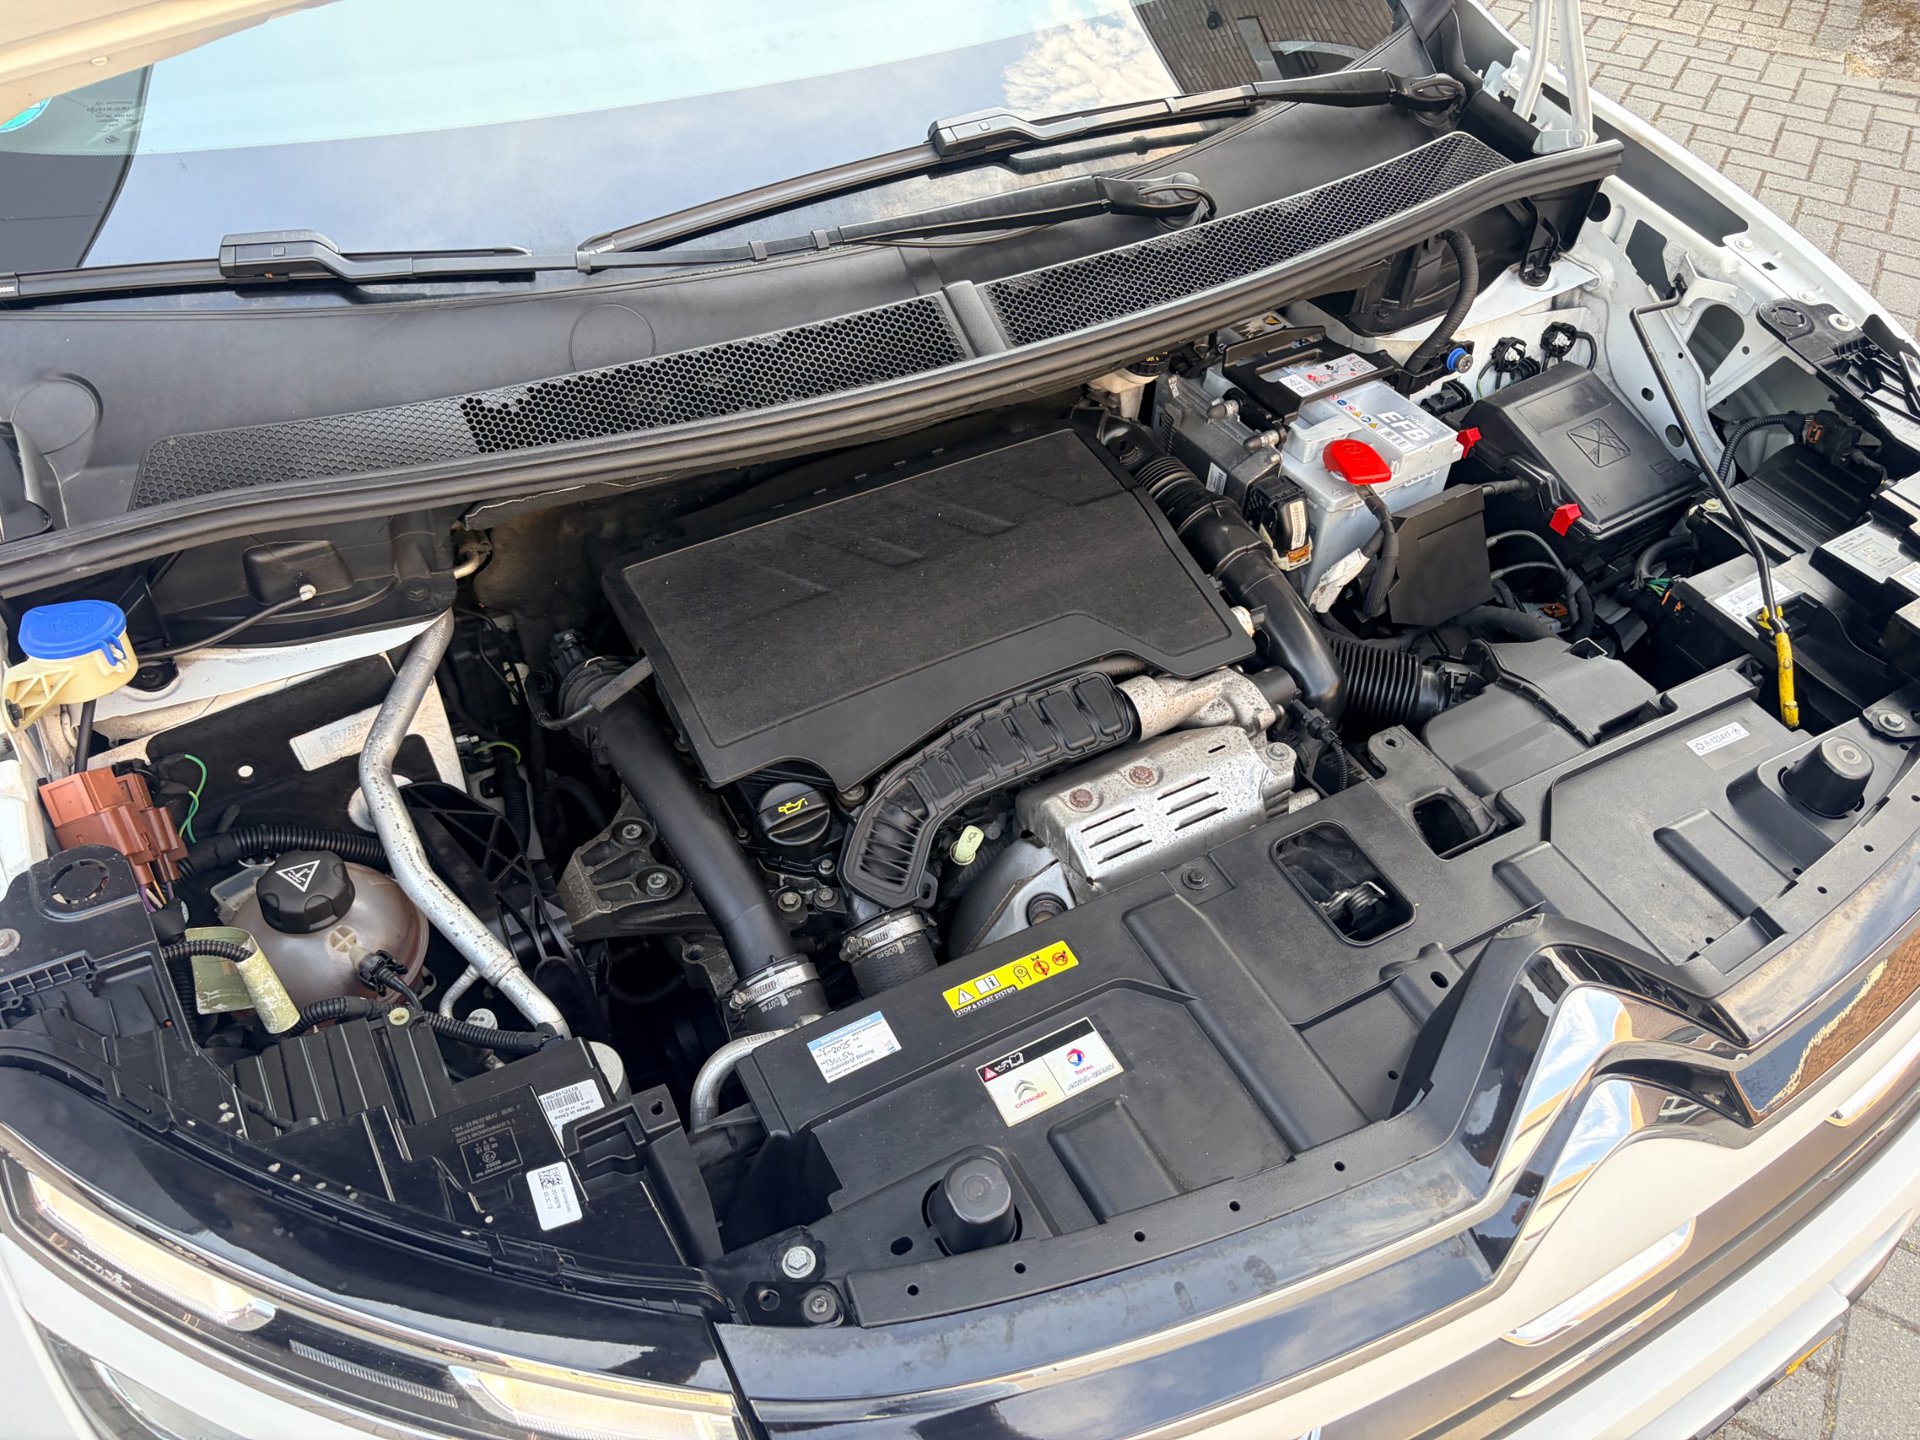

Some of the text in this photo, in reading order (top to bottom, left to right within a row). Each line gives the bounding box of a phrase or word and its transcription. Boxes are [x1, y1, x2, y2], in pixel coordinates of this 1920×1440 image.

[1377, 411, 1430, 440] EFB
[1405, 414, 1439, 436] DYNAMIC
[956, 1005, 972, 1016] STOP
[977, 996, 995, 1007] START
[995, 985, 1017, 999] SYSTEM
[1074, 1064, 1095, 1076] TOTAL
[1014, 1090, 1048, 1110] CITROËN
